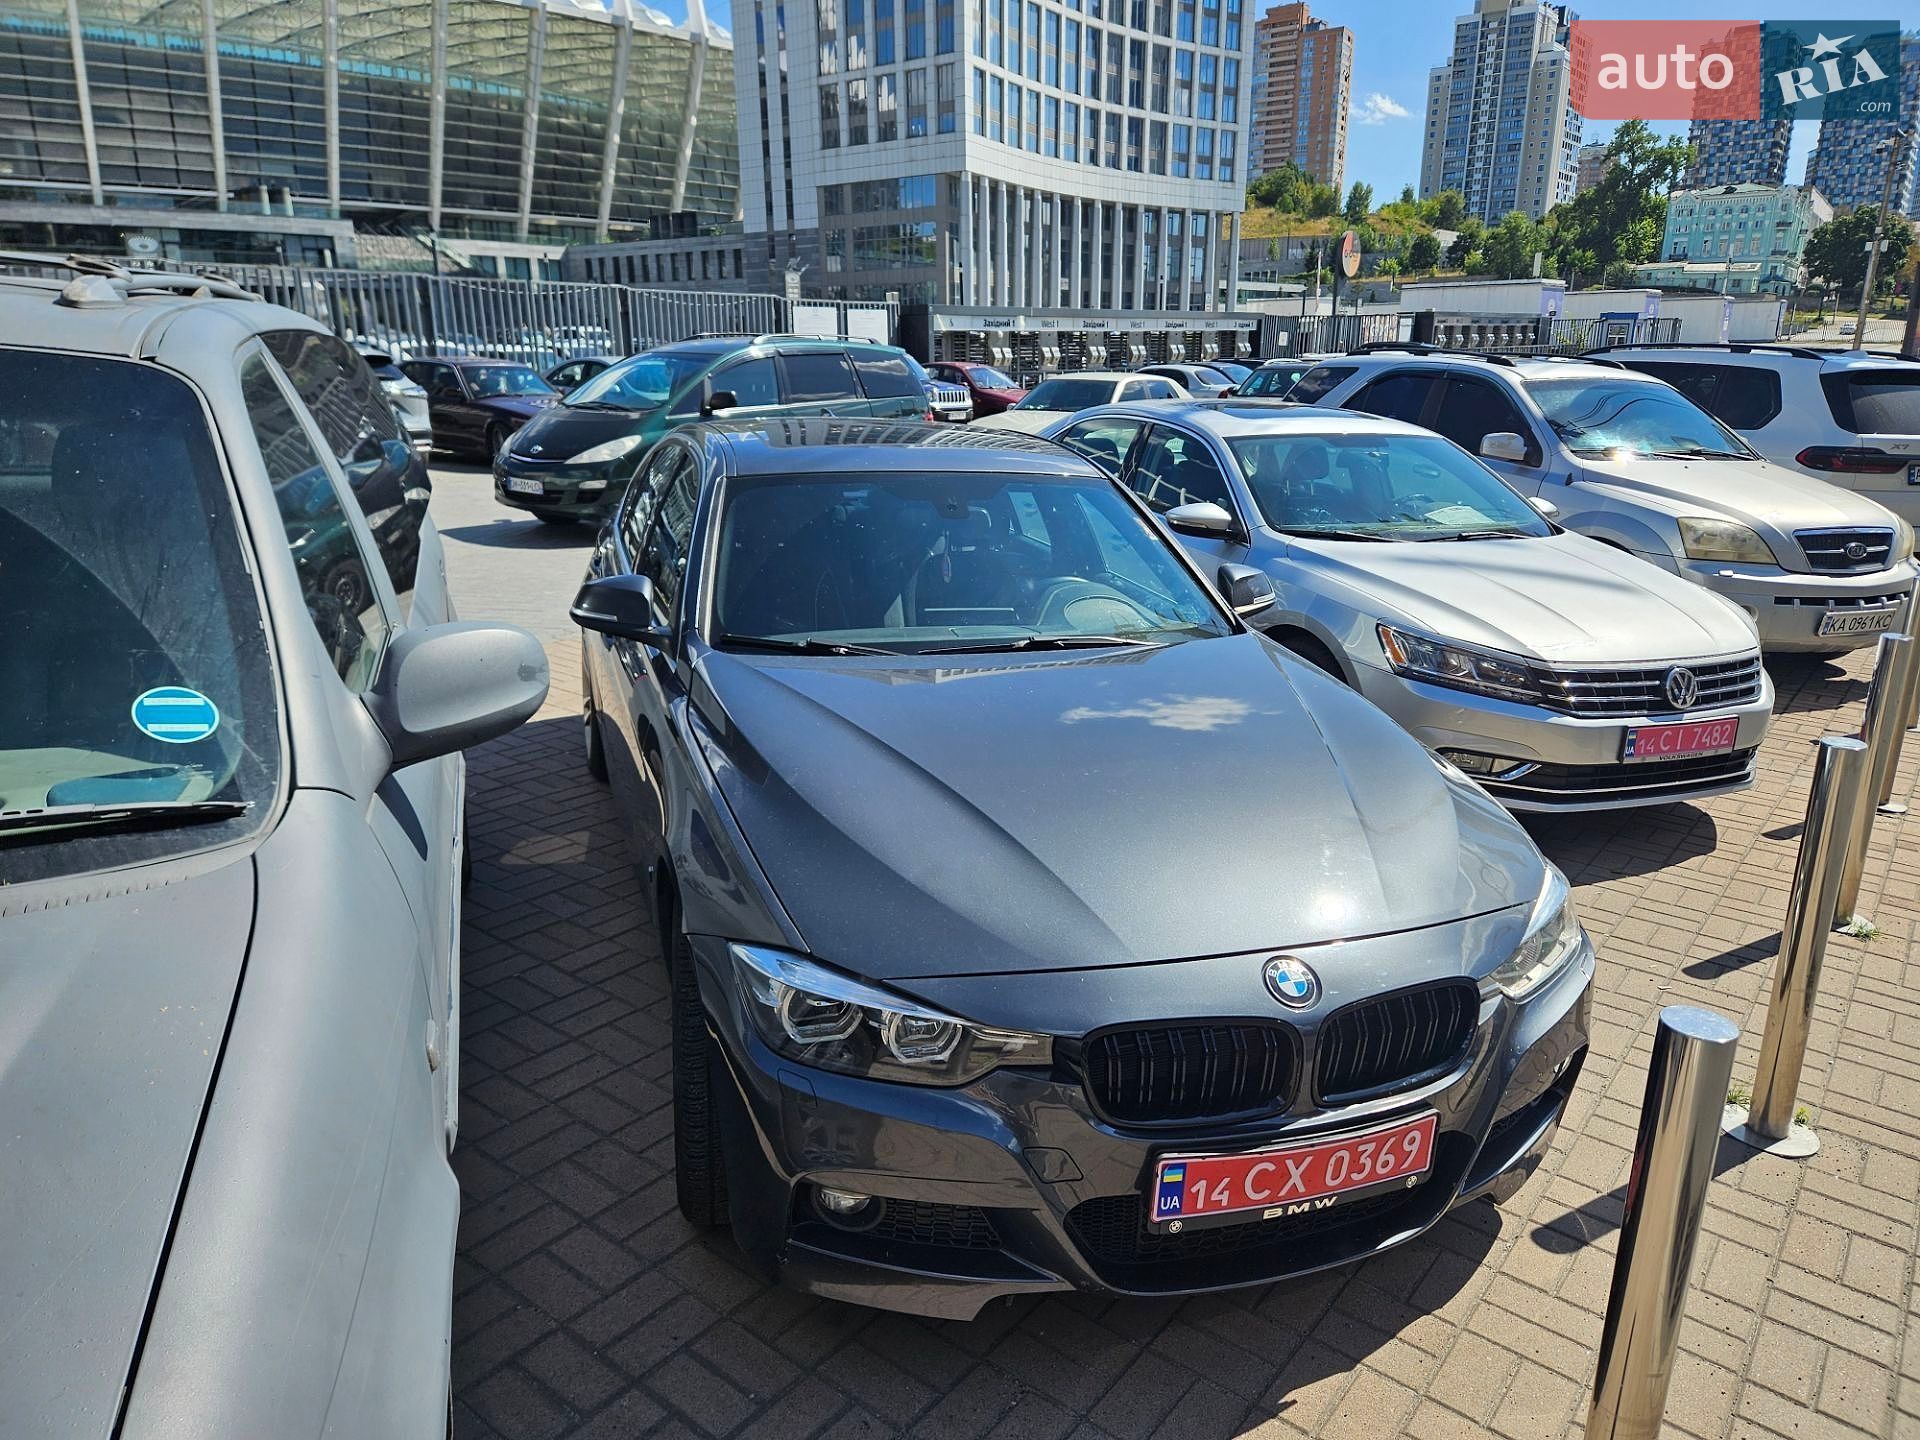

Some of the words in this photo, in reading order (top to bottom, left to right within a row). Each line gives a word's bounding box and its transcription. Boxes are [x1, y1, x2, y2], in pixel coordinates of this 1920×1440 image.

[1041, 319, 1055, 328] West
[1828, 618, 1846, 632] KA
[1848, 615, 1875, 631] 0961
[1875, 614, 1892, 629] KC
[1637, 737, 1656, 754] 14
[1691, 724, 1731, 749] 7482
[1625, 745, 1635, 755] UA
[1190, 1177, 1231, 1209] 14
[1244, 1155, 1312, 1200] CX
[1325, 1130, 1422, 1187] 0369
[1160, 1195, 1180, 1210] UA
[1263, 1196, 1338, 1220] BMW
